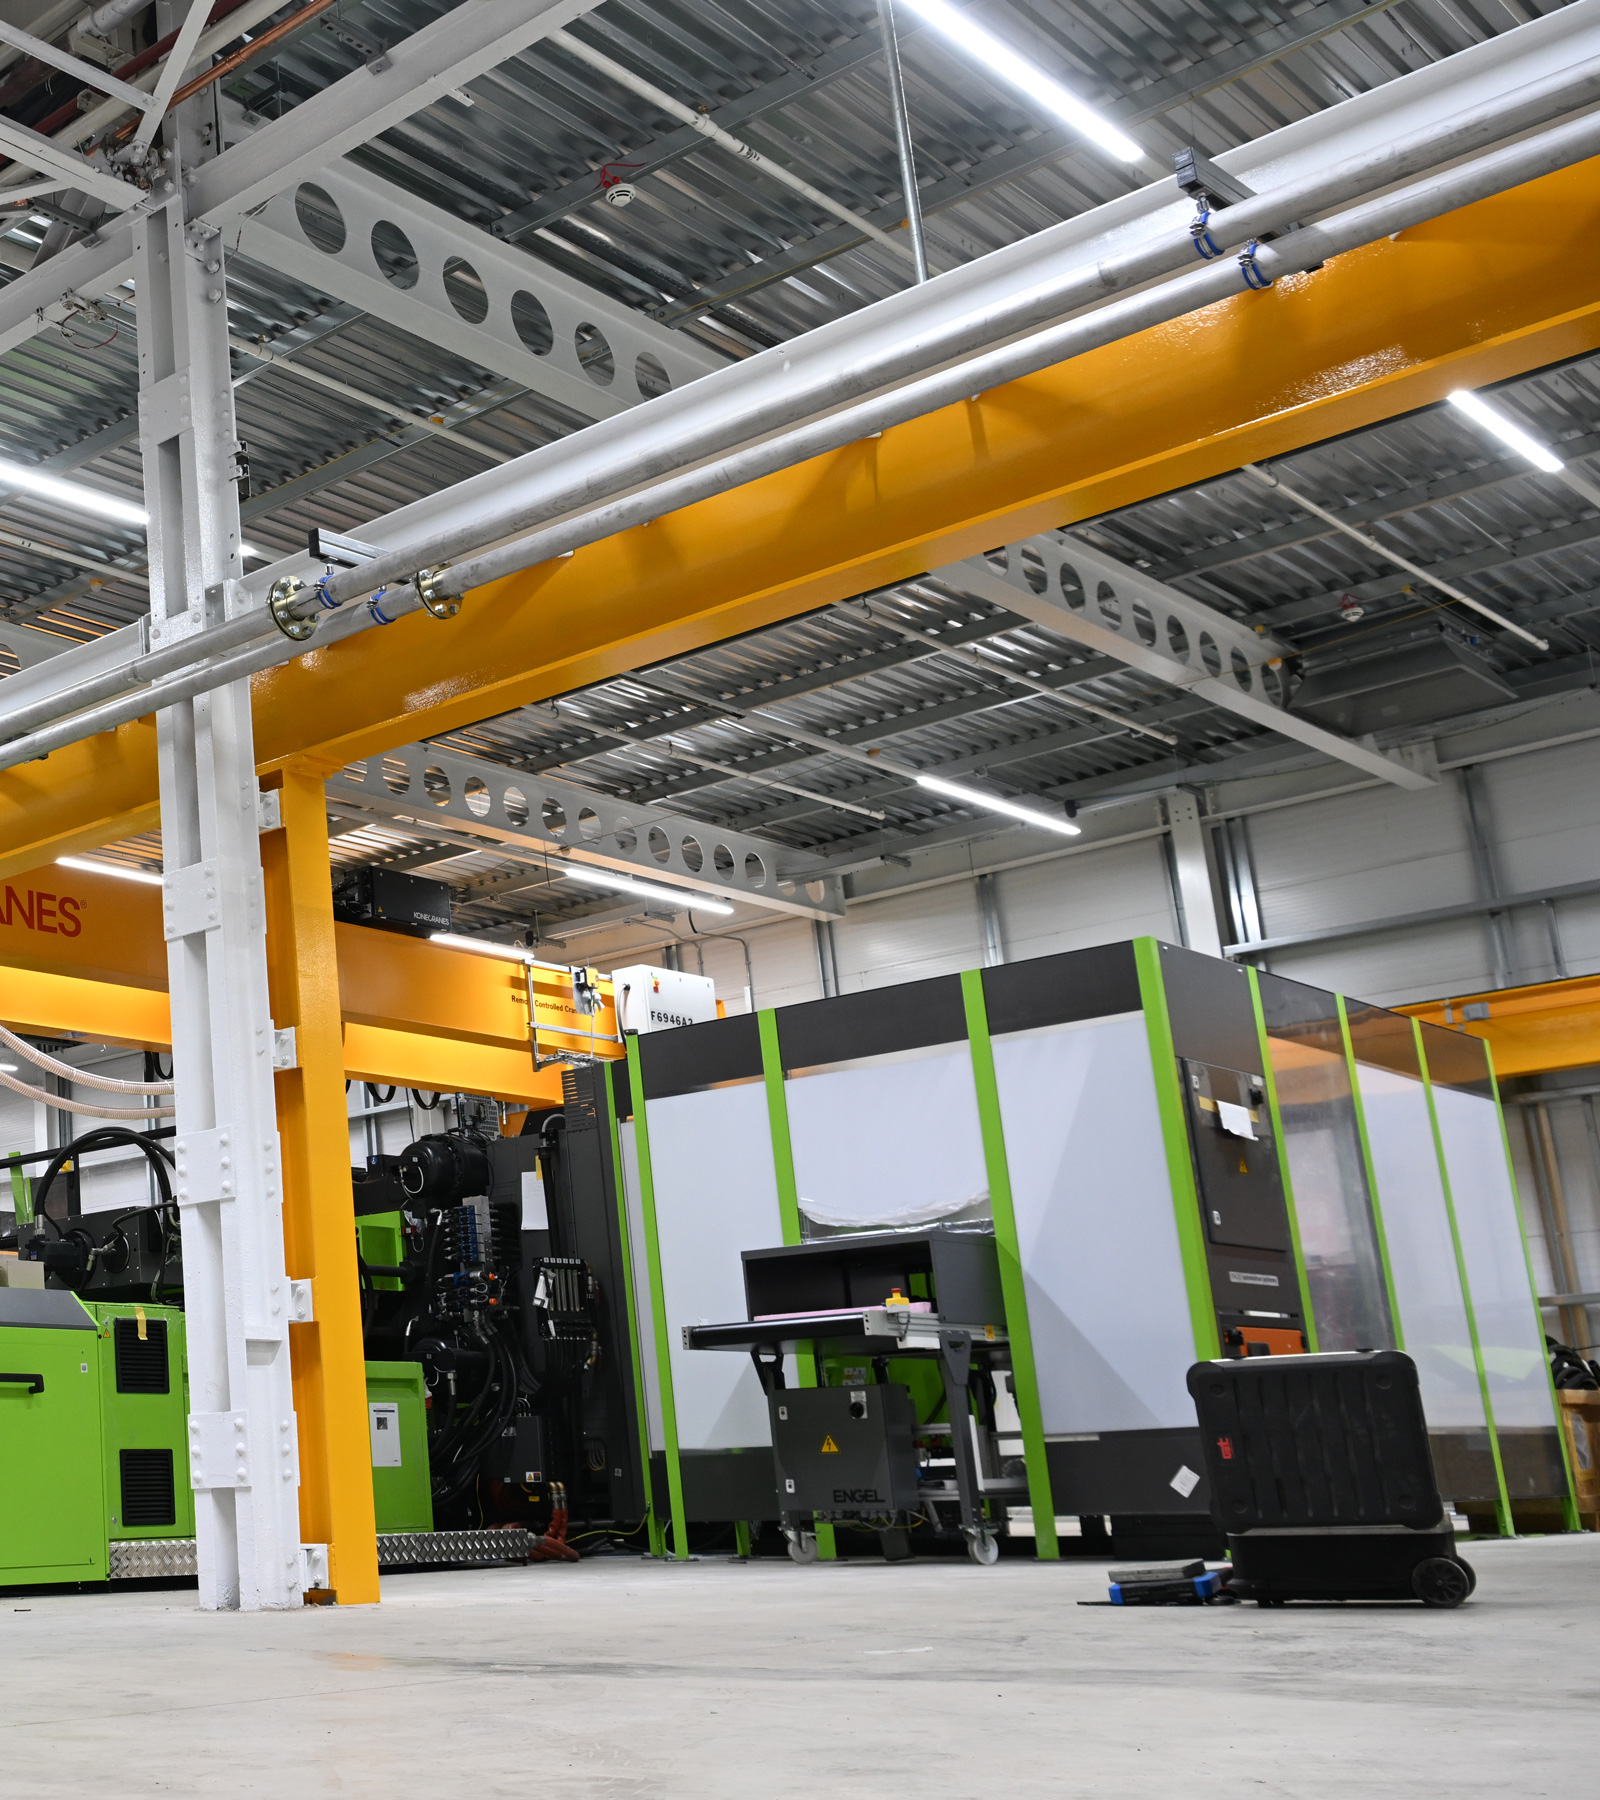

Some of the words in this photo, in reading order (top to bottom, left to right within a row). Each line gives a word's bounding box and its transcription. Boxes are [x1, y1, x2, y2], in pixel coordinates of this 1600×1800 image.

[534, 999, 564, 1012] Controlled
[564, 1005, 579, 1014] Cran
[833, 1489, 886, 1503] ENGEL
